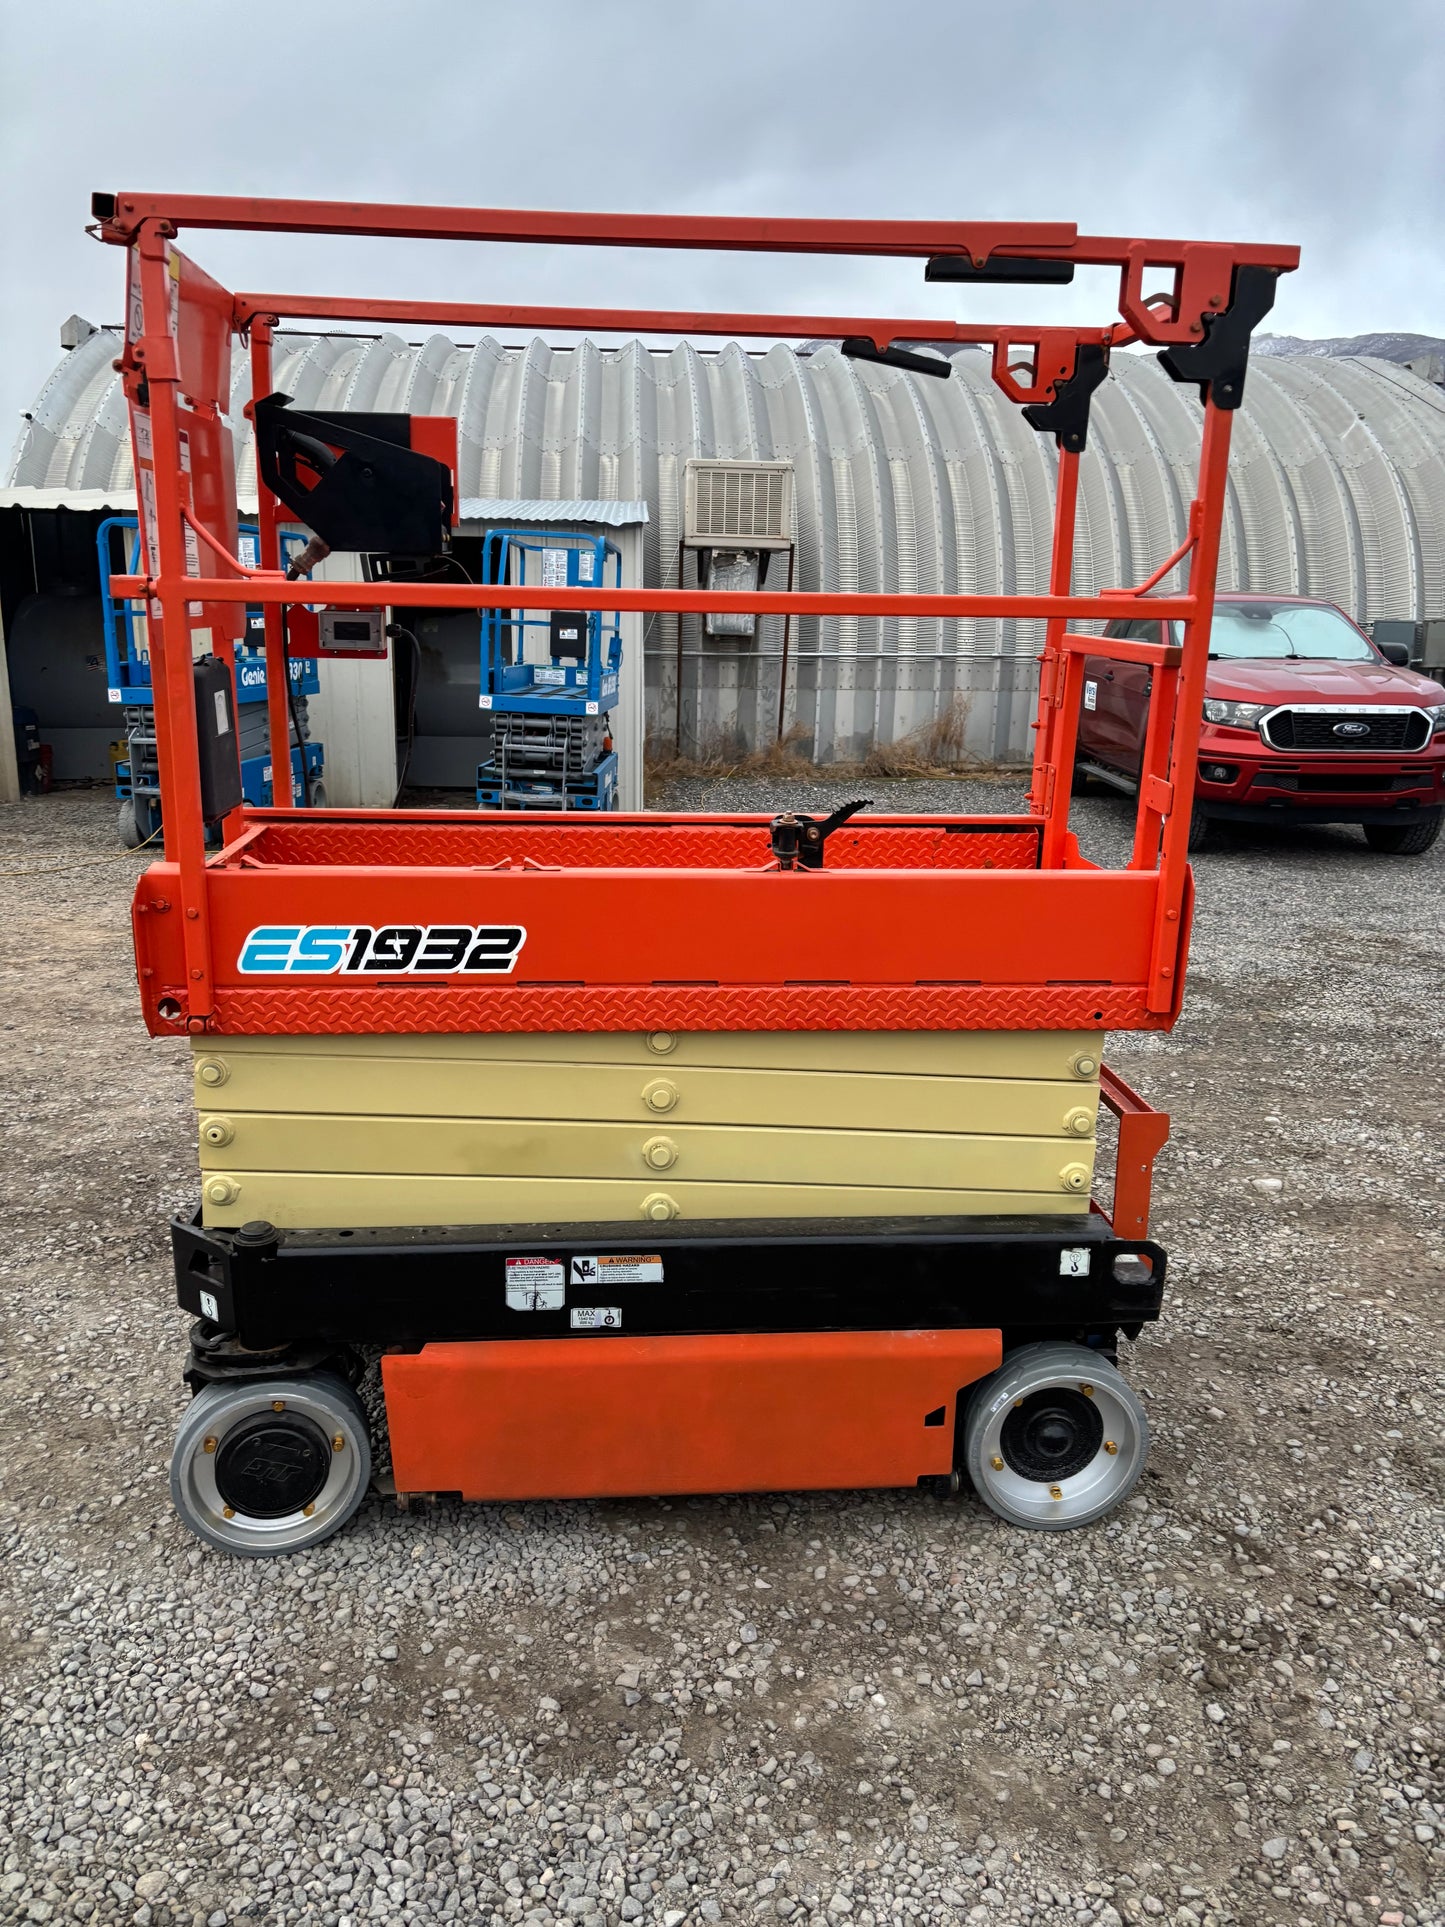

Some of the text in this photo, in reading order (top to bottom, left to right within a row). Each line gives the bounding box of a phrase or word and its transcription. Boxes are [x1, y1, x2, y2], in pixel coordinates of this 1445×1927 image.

[241, 666, 266, 687] Genie
[1342, 724, 1364, 734] Ford
[240, 928, 523, 972] ES1932
[616, 1256, 652, 1264] WARNING
